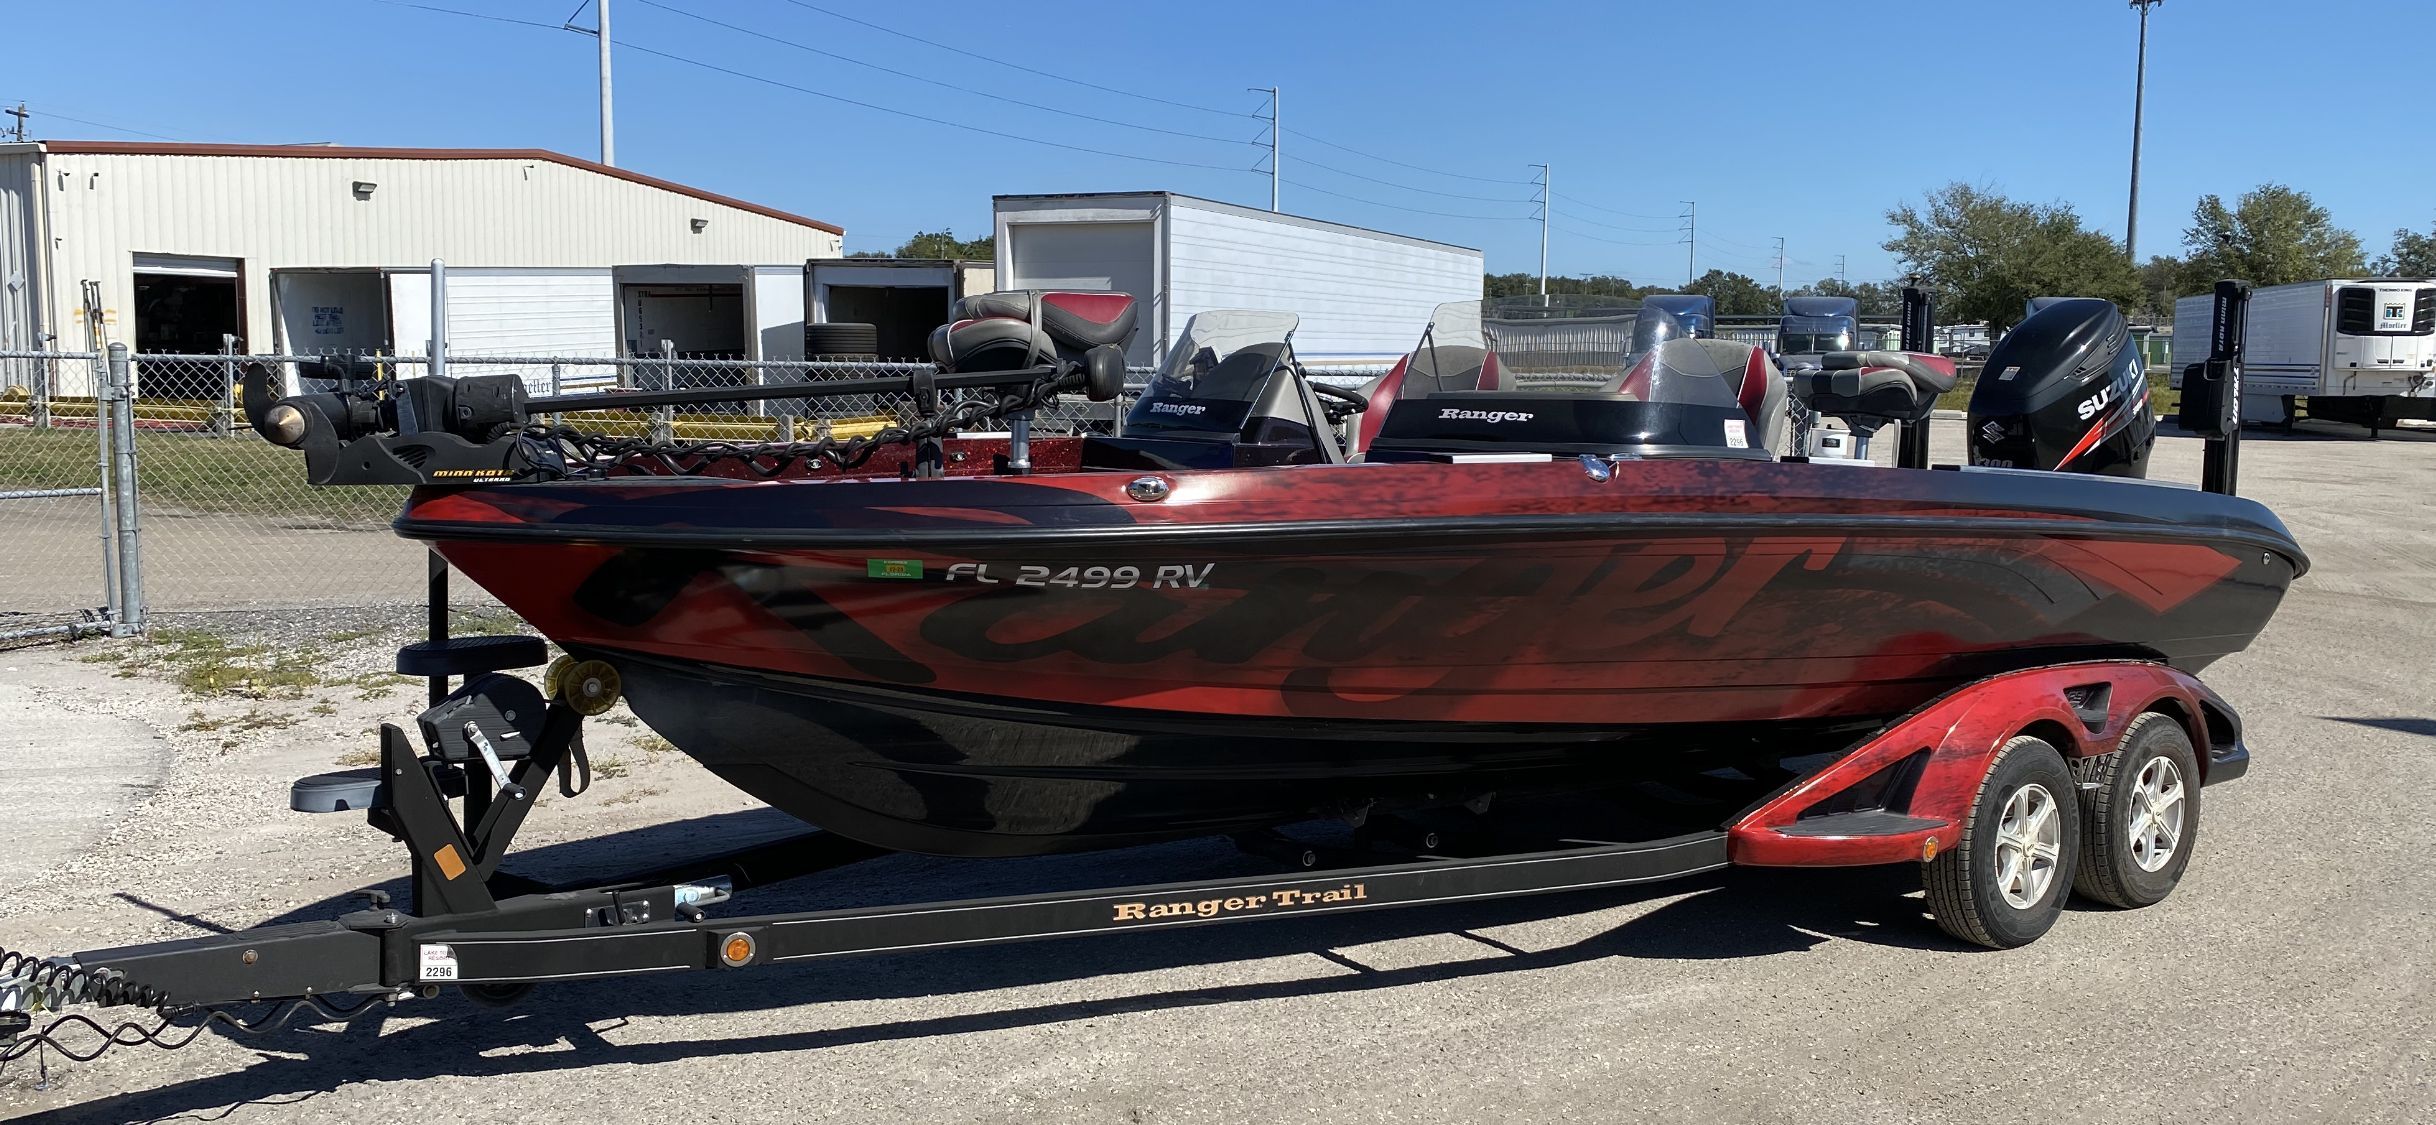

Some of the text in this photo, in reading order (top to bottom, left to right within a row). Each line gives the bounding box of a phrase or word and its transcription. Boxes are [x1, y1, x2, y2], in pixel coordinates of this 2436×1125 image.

[2077, 358, 2139, 421] SUZUKI
[2232, 366, 2240, 425] TALON
[1149, 402, 1206, 416] Ranger
[1438, 408, 1534, 424] Ranger
[432, 469, 475, 479] MINN
[946, 563, 1215, 589] FL 2499 RV
[1112, 884, 1368, 921] Ranger Trail
[426, 967, 452, 977] 2296
